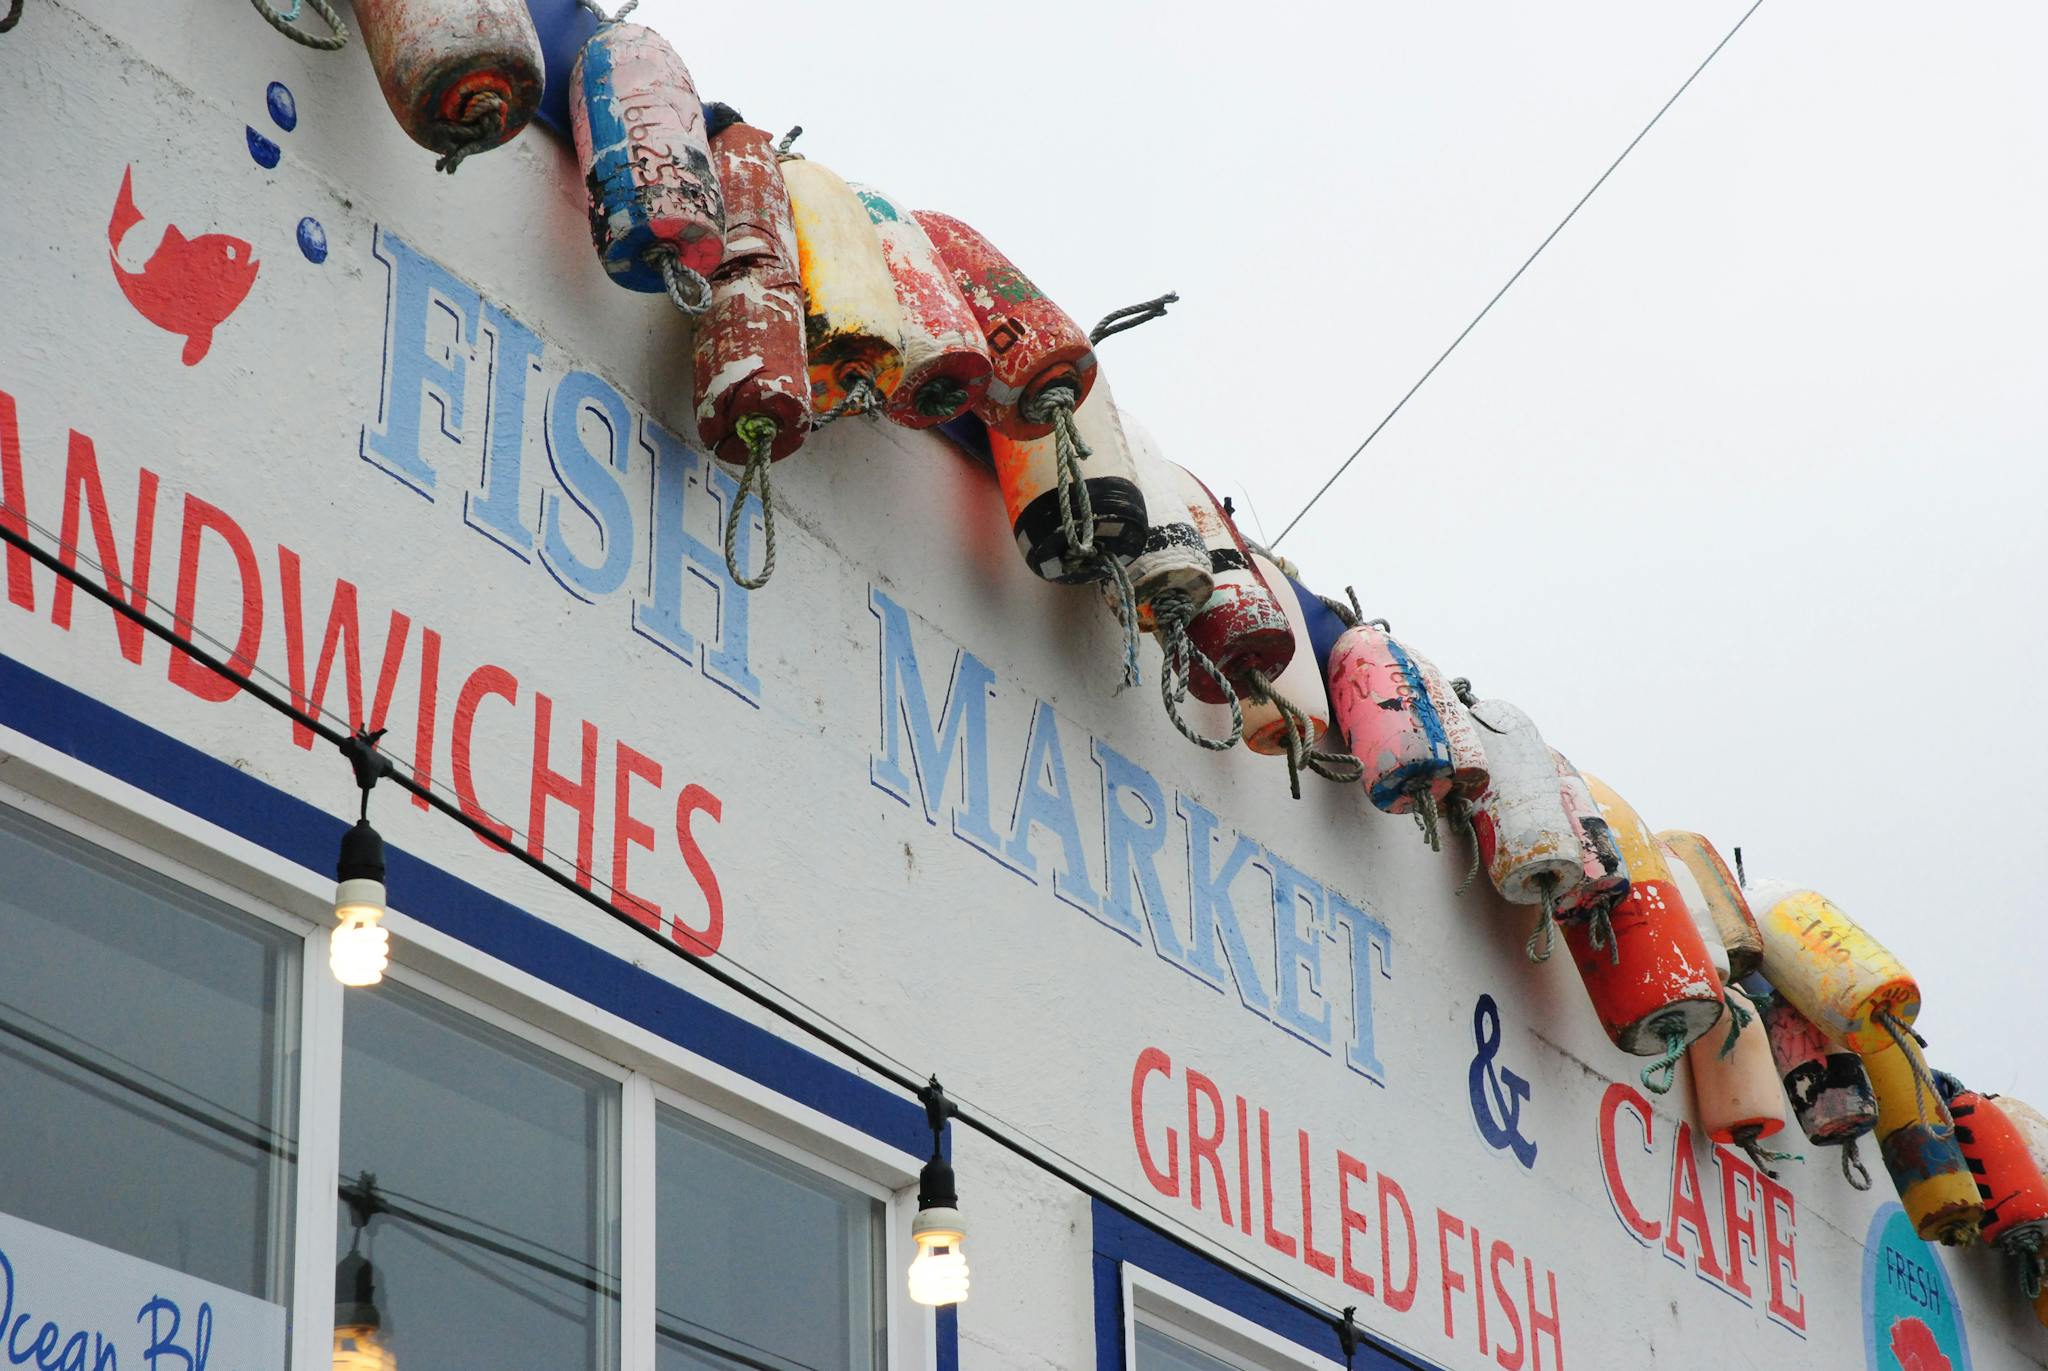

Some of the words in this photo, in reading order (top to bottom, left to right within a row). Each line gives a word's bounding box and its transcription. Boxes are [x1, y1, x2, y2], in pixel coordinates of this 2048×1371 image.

[360, 223, 762, 709] FISH
[868, 582, 1392, 1088] MARKET
[1468, 993, 1538, 1170] &
[1596, 1082, 1807, 1340] CAFE
[1131, 1046, 1418, 1313] GRILLED
[1436, 1207, 1565, 1371] FISH
[1886, 1246, 1941, 1316] FRESH
